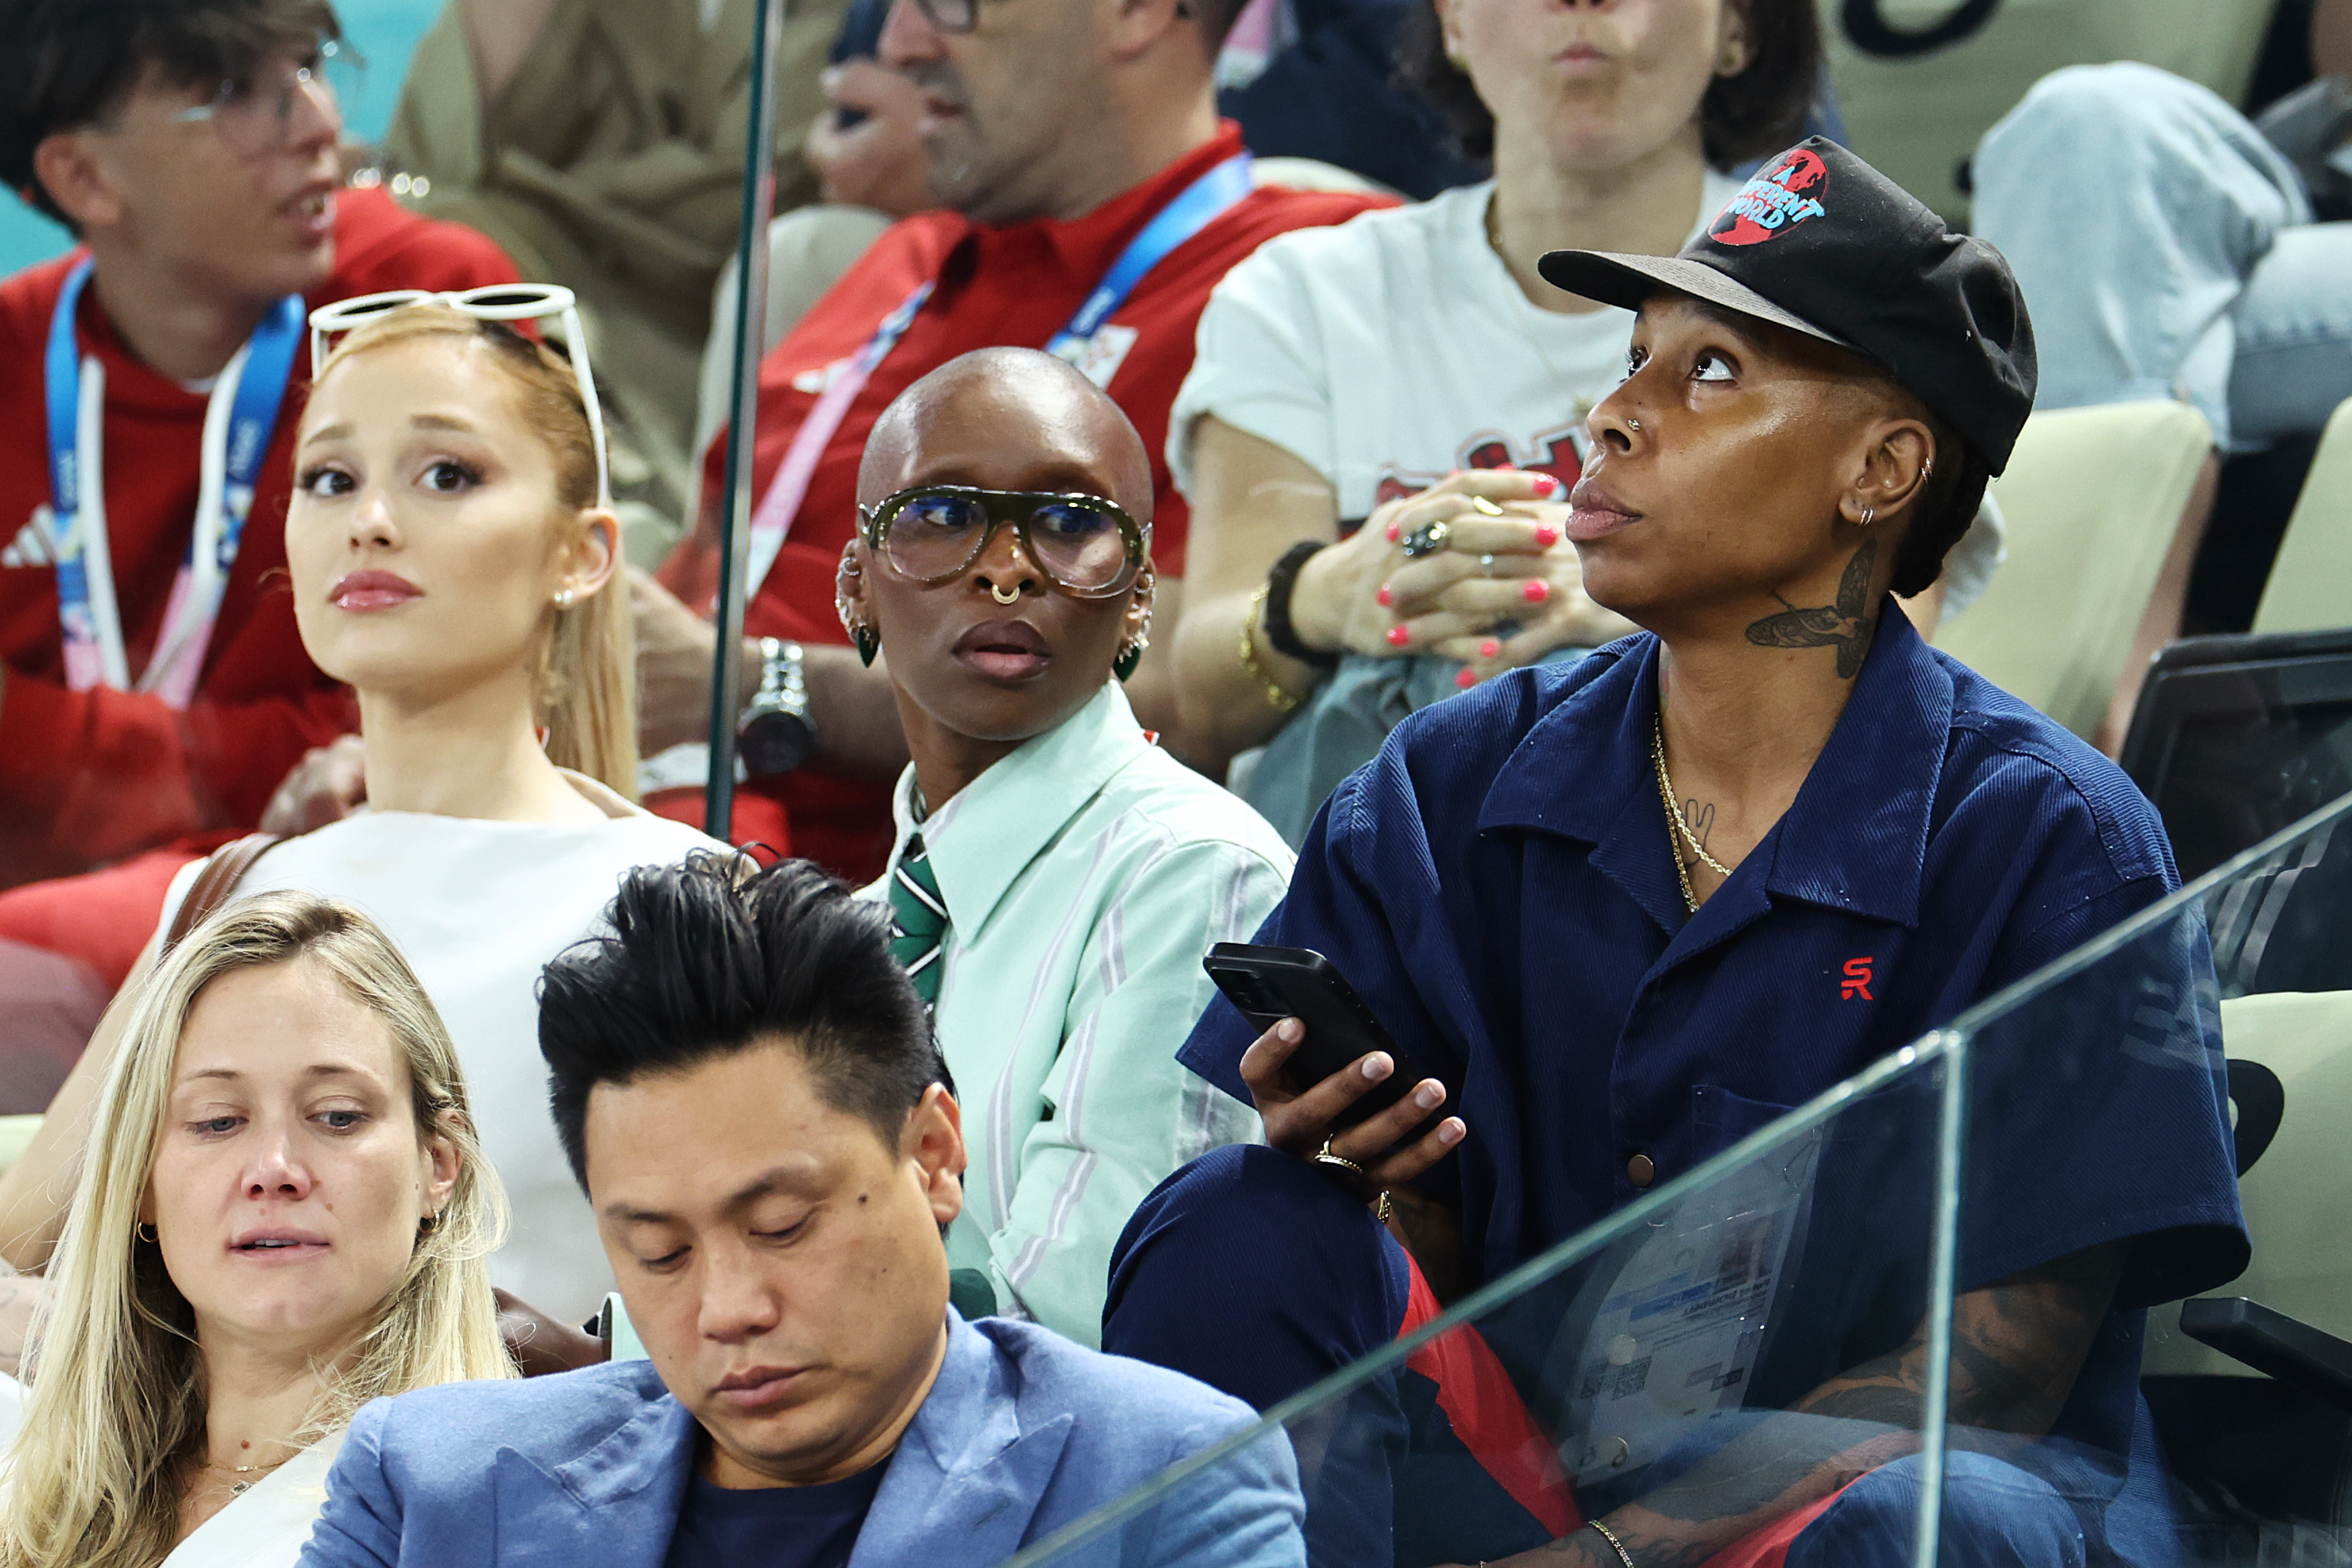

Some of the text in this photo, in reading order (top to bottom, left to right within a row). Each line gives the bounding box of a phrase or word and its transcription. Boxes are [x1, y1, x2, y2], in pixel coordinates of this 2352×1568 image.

[1772, 166, 1796, 185] A
[1726, 198, 1785, 229] WORLD
[1732, 179, 1825, 223] FFERENT
